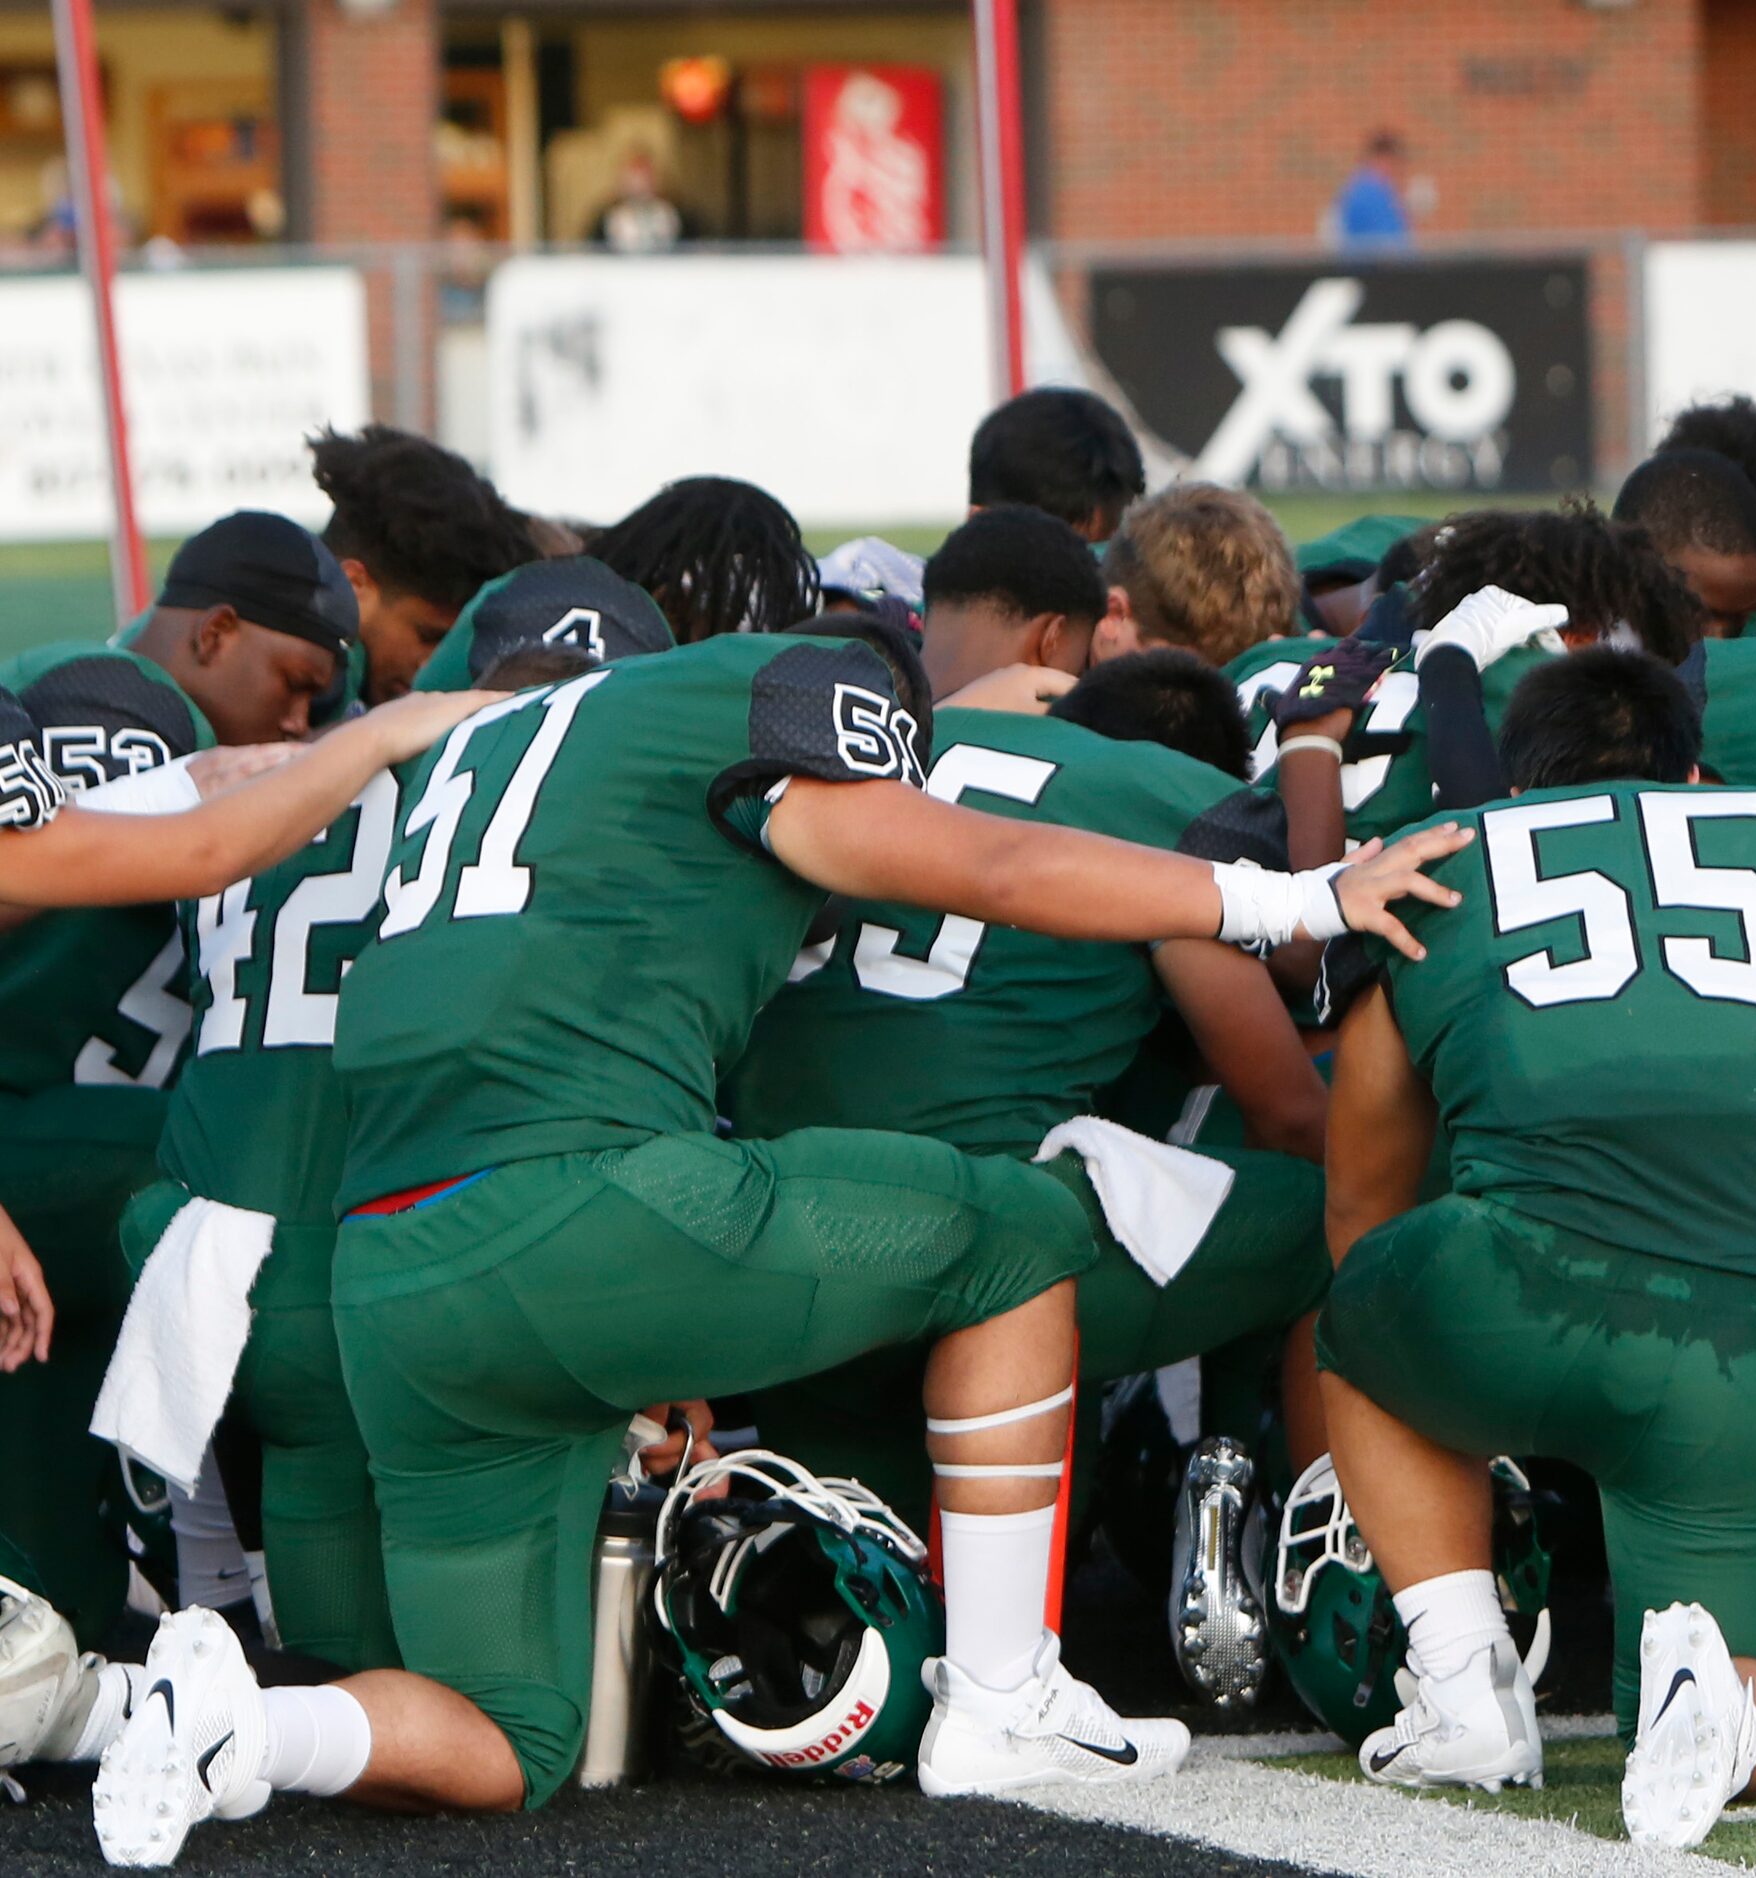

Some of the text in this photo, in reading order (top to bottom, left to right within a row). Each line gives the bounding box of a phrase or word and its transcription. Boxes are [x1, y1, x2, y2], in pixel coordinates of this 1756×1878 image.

[1193, 277, 1516, 491] XTO
[833, 682, 928, 793] 51
[379, 670, 612, 943] 51
[762, 1699, 875, 1768] Riddell
[1038, 1687, 1059, 1725] ALPHA
